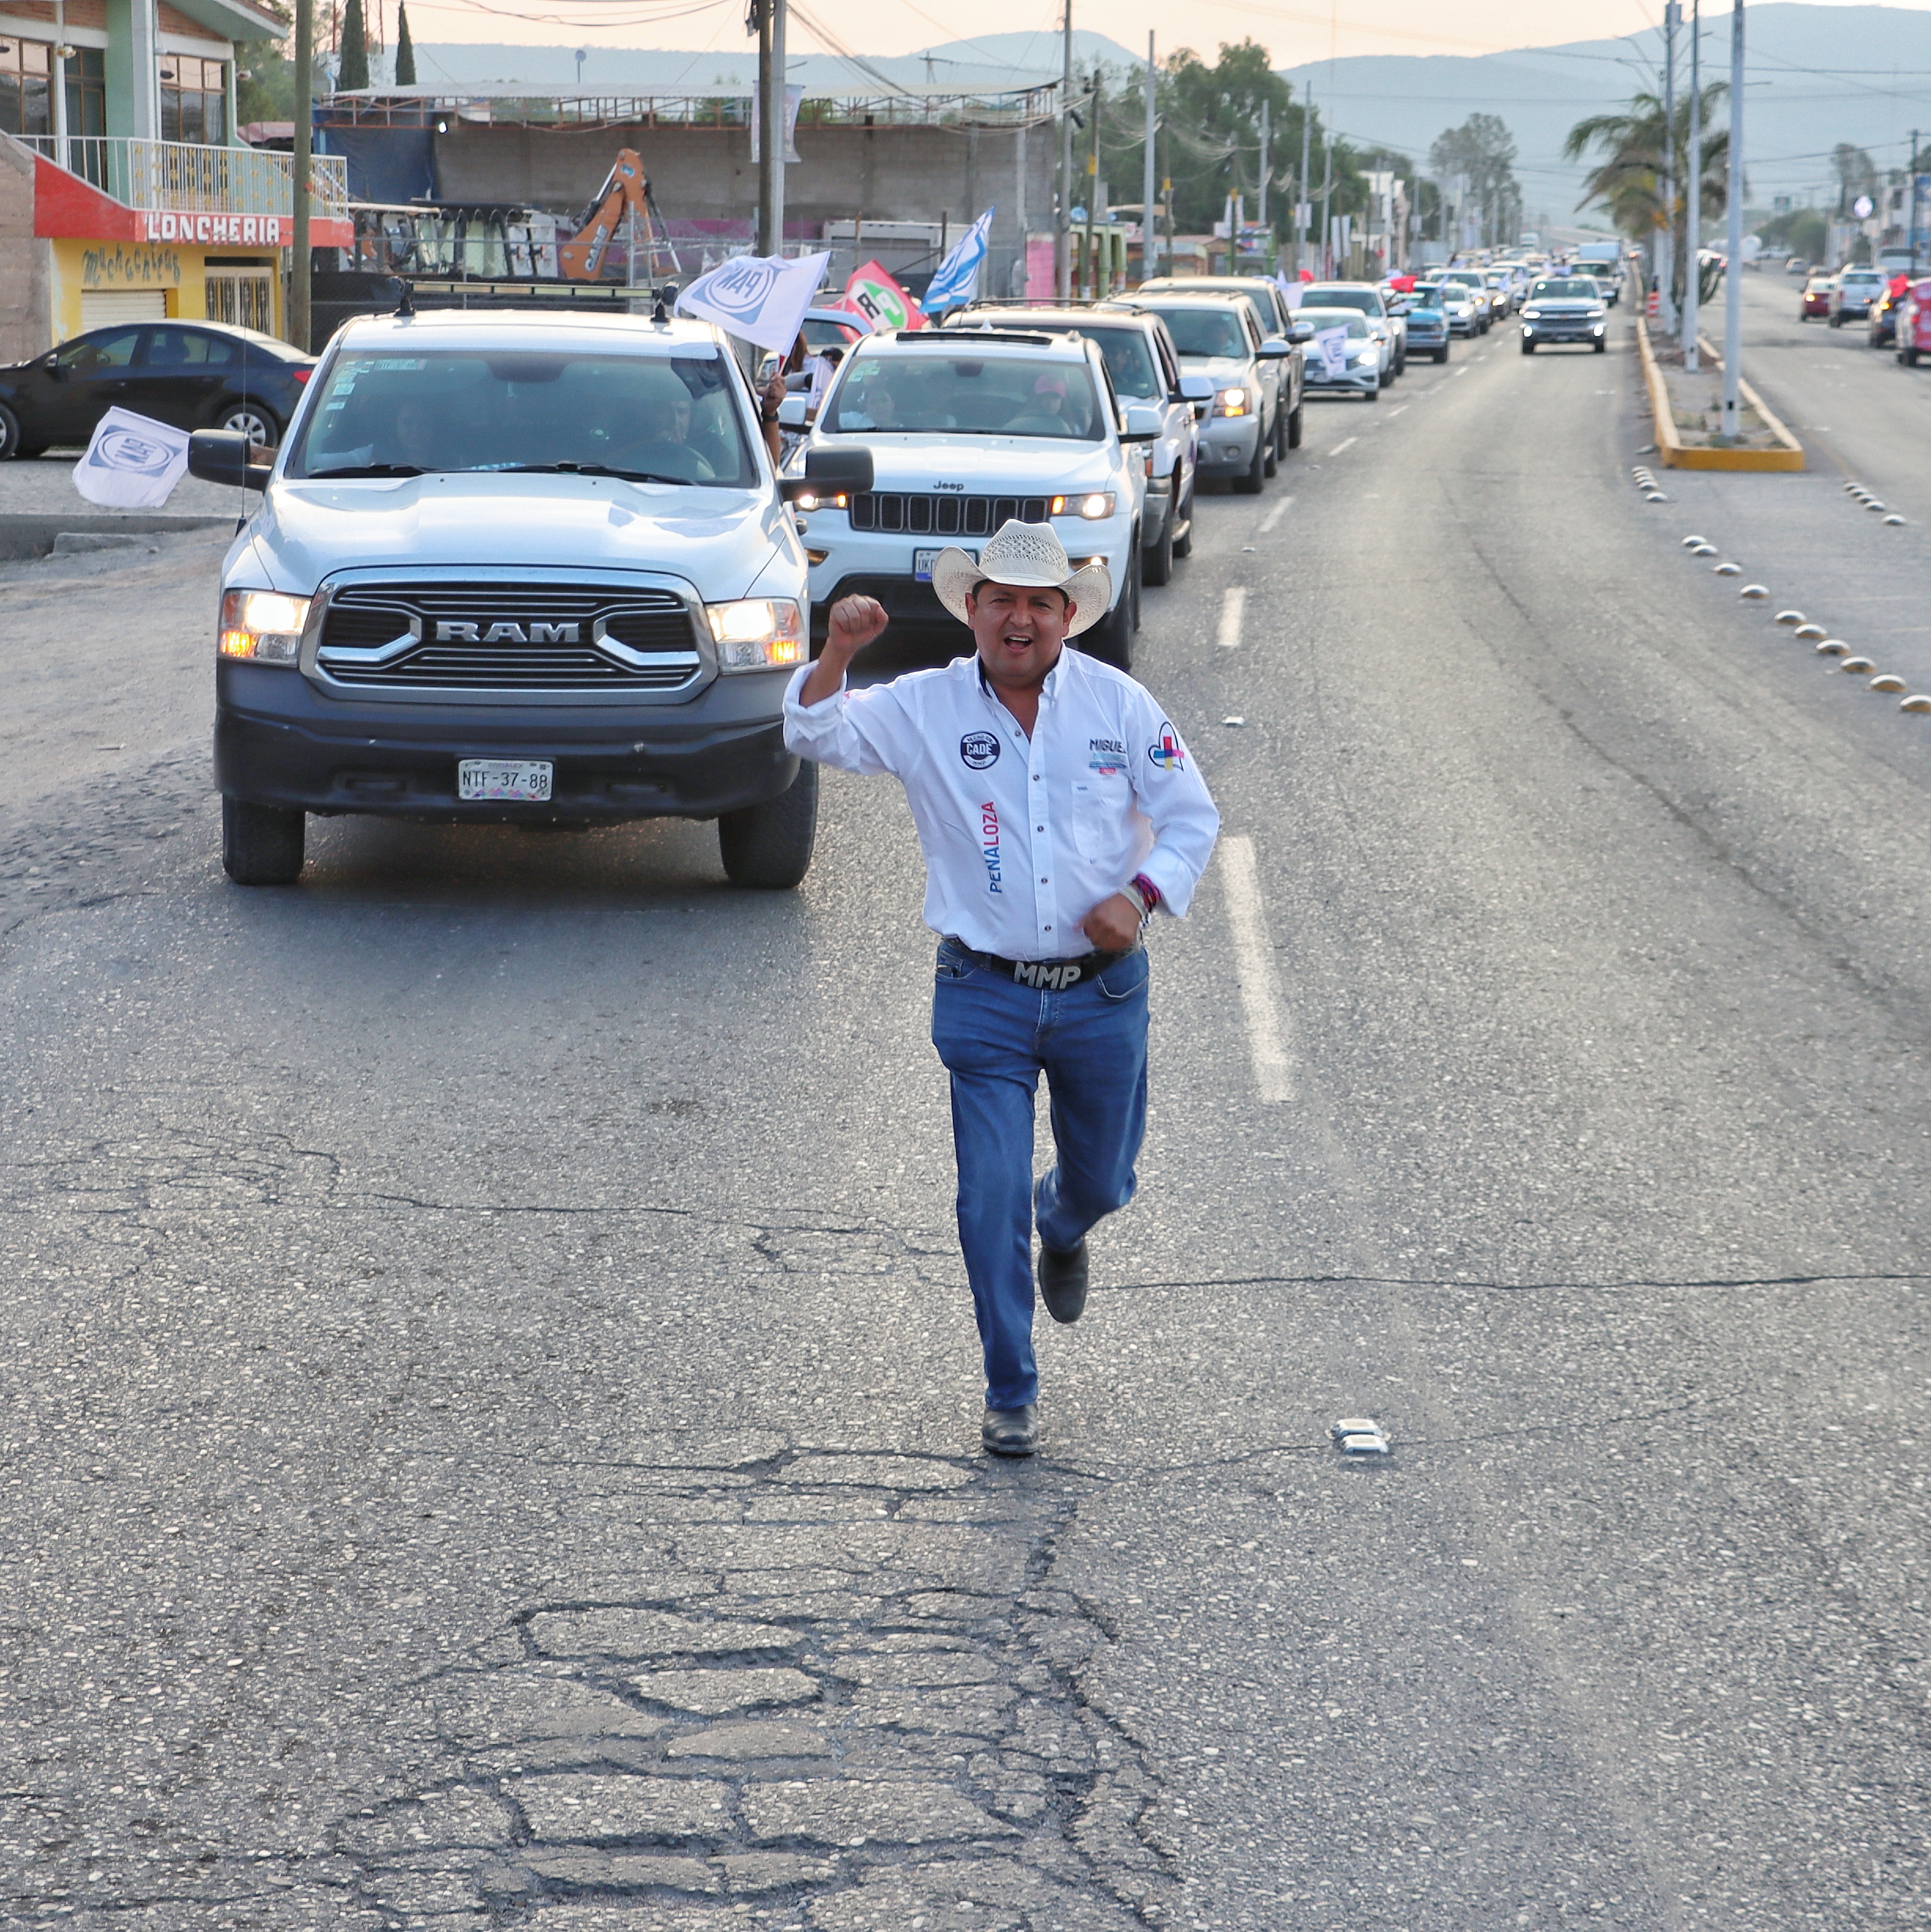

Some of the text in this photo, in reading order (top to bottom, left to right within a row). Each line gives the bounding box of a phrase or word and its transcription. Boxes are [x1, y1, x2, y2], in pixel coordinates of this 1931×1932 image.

[147, 213, 279, 245] LONCHERIA
[934, 481, 964, 491] Jeep
[436, 621, 579, 642] RAM
[966, 743, 992, 755] CADE
[463, 770, 548, 789] NTF-37-88
[981, 801, 1002, 894] PENALOZA
[1014, 961, 1081, 989] MMP
